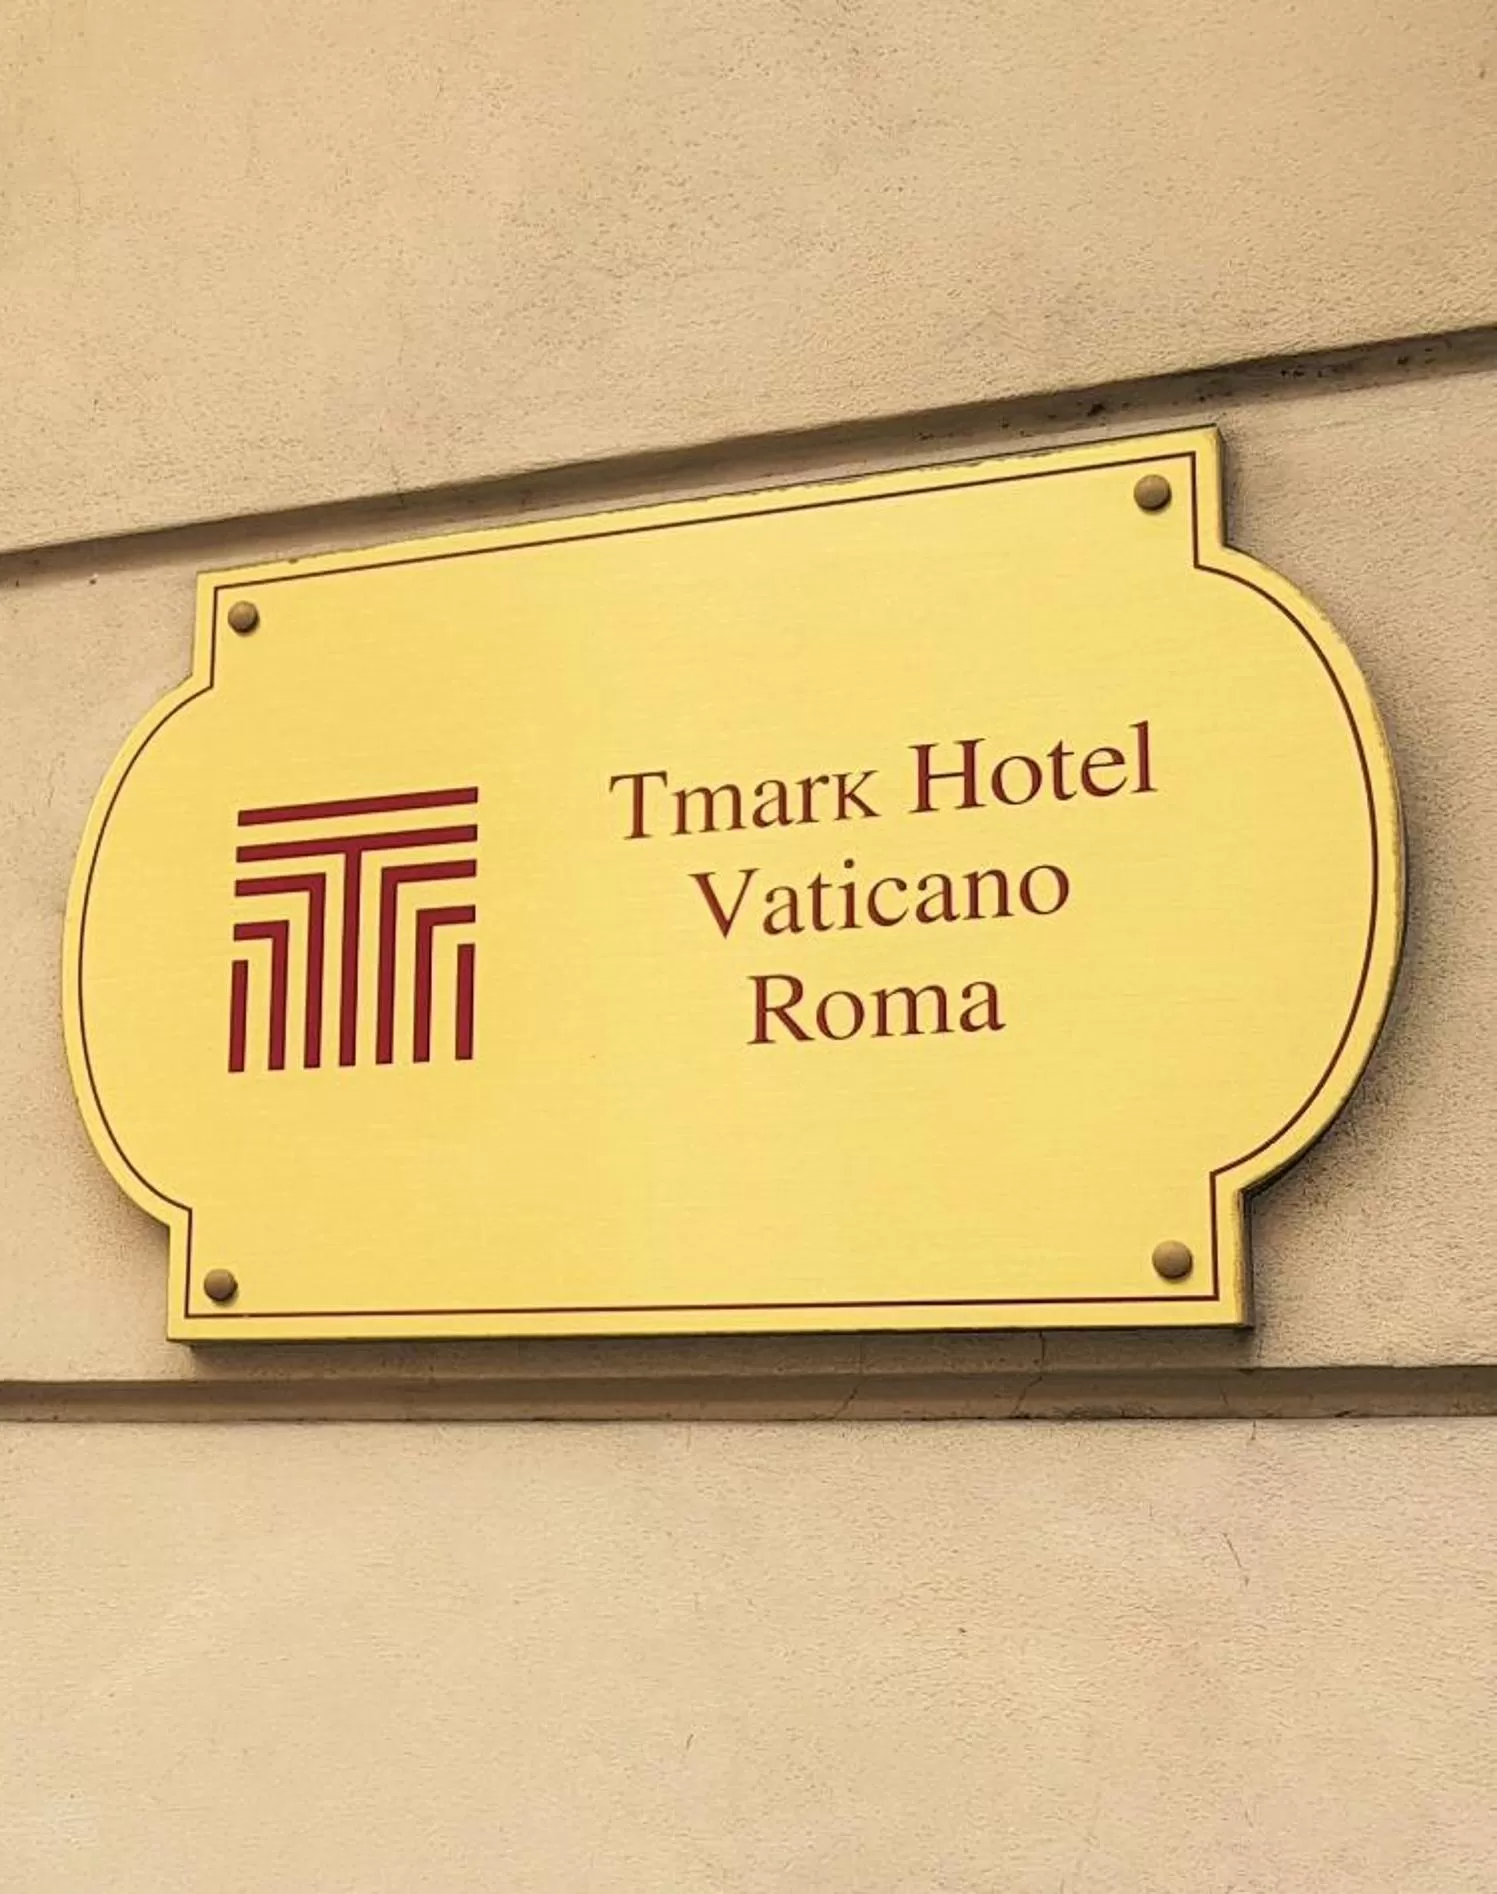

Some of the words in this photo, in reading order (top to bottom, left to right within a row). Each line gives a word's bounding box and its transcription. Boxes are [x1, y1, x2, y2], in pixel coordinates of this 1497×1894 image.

[909, 720, 1158, 814] Hotel
[688, 858, 1070, 939] Vaticano
[747, 974, 1006, 1045] Roma
